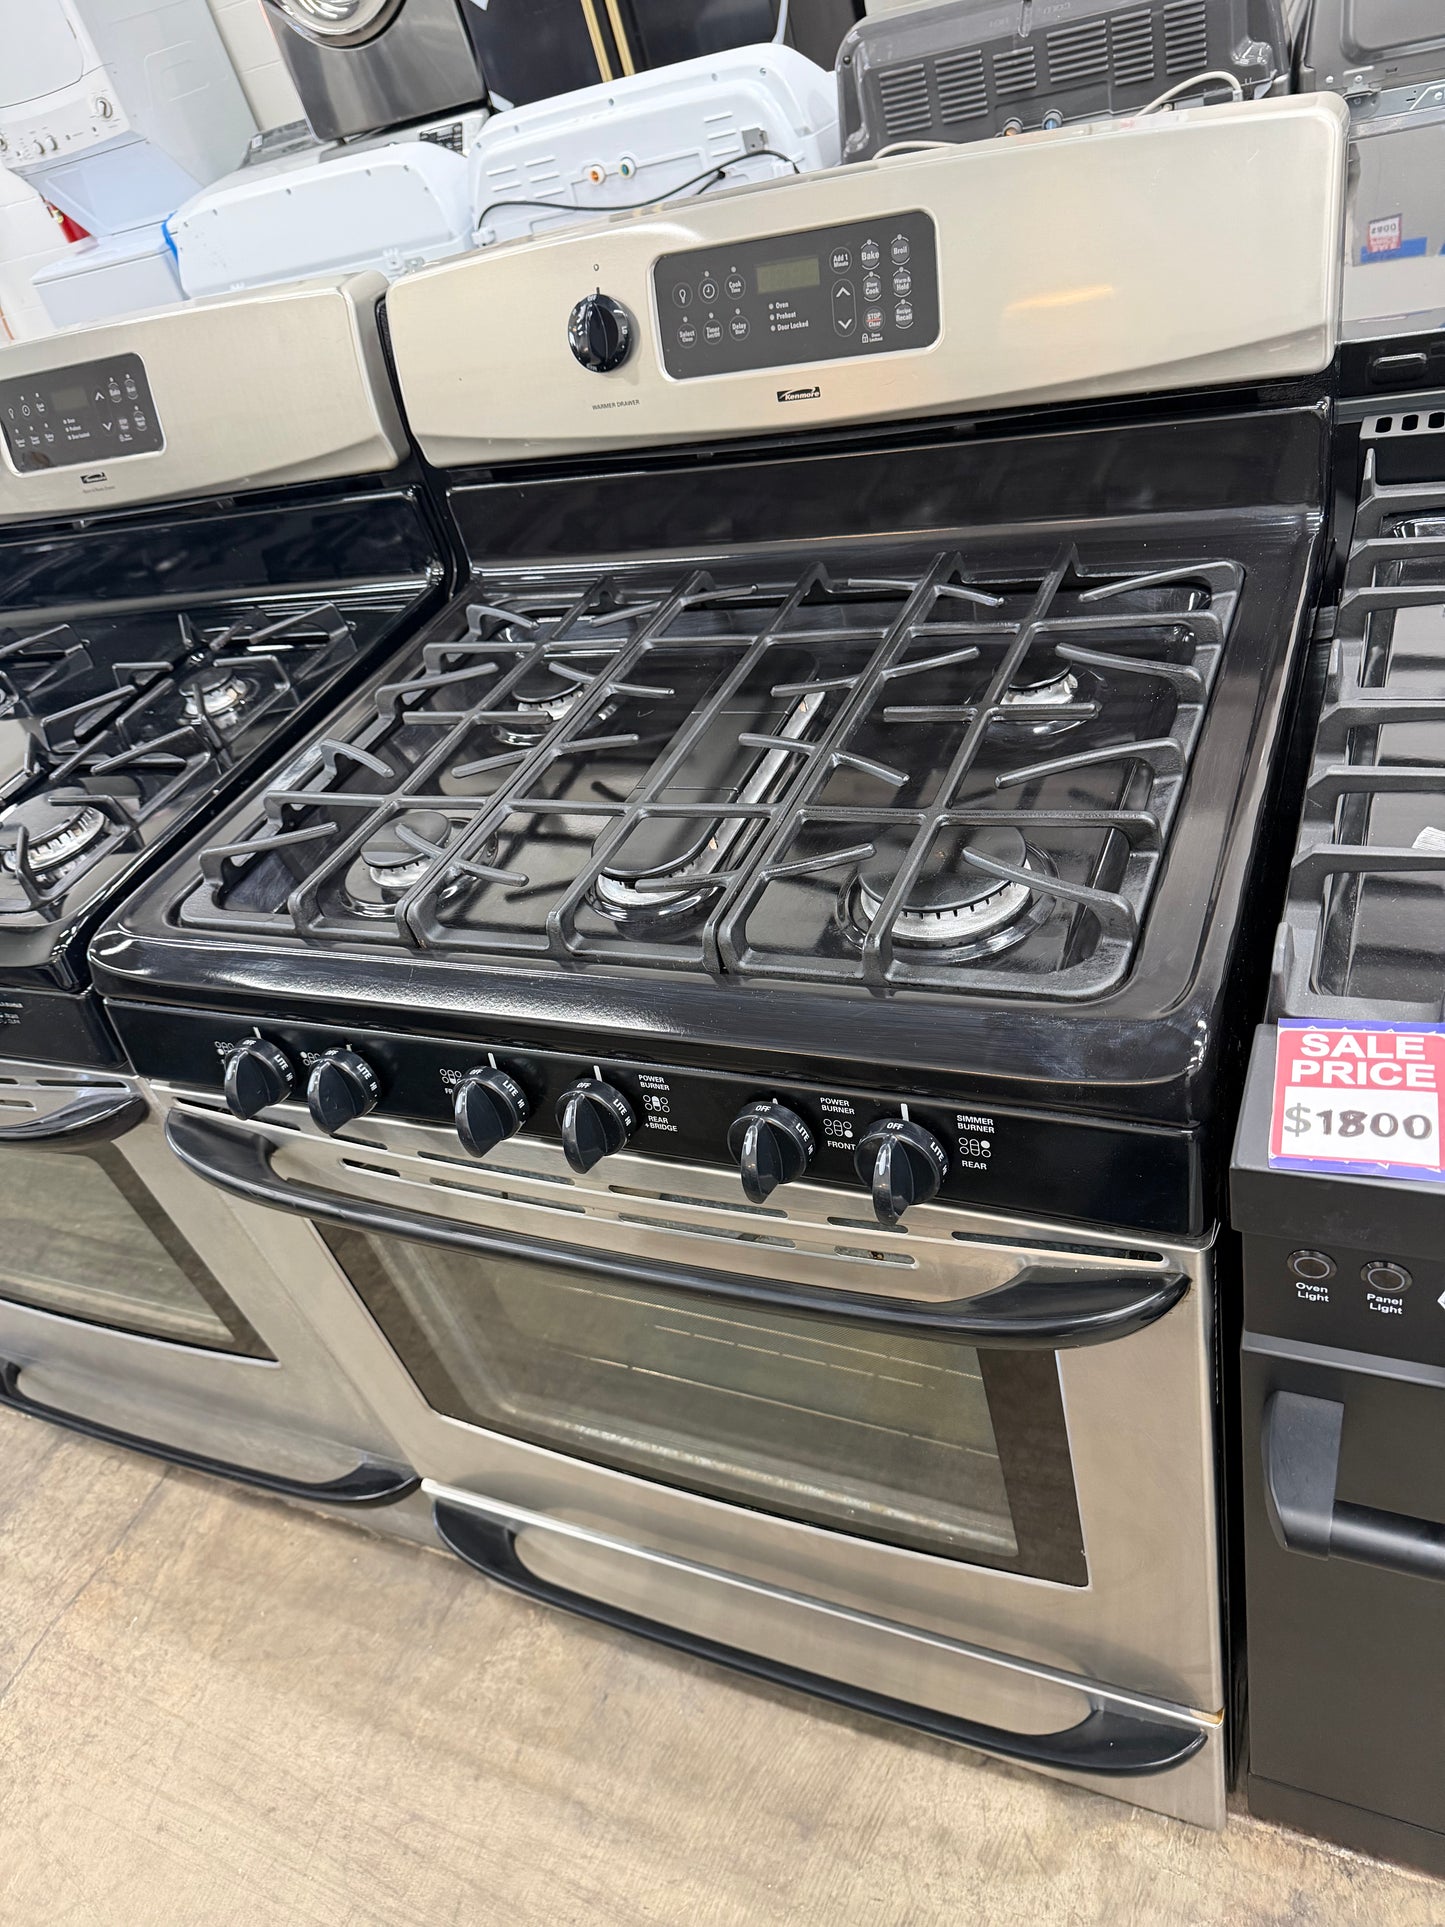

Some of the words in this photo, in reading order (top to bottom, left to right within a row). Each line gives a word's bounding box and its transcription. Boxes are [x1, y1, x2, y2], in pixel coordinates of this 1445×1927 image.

[861, 251, 880, 261] Bake
[893, 246, 908, 255] Broil
[833, 254, 844, 262] Add
[728, 280, 742, 288] Cook
[896, 282, 909, 290] Hold
[865, 287, 879, 295] Cook
[776, 311, 797, 320] Preheat
[732, 322, 747, 330] Delay
[777, 323, 790, 331] Door
[790, 320, 809, 330] Locked
[679, 330, 695, 338] Select
[781, 389, 821, 401] Kenmore
[592, 402, 617, 411] WARMER
[617, 399, 641, 408] DRAWER
[1300, 1033, 1426, 1061] SALE
[273, 1054, 289, 1071] LITE
[356, 1063, 373, 1080] LITE
[1291, 1059, 1437, 1089] PRICE
[638, 1074, 665, 1084] POWER
[502, 1080, 519, 1097] LITE
[639, 1081, 670, 1091] BURNER
[613, 1098, 628, 1116] LITE
[820, 1097, 850, 1107] POWER
[755, 1105, 772, 1113] OFF
[821, 1104, 855, 1115] BURNER
[648, 1115, 669, 1124] REAR
[956, 1114, 994, 1126] SIMMER
[1283, 1102, 1433, 1140] $1800
[886, 1122, 904, 1130] OFF
[957, 1122, 995, 1134] BURNER
[795, 1122, 810, 1142] LITE
[827, 1140, 857, 1151] FRONT
[930, 1141, 945, 1162] LITE
[961, 1159, 988, 1171] REAR
[1295, 1282, 1328, 1293] Oven
[1297, 1291, 1330, 1303] Light
[1366, 1293, 1403, 1306] Panel
[1369, 1302, 1403, 1315] Light
